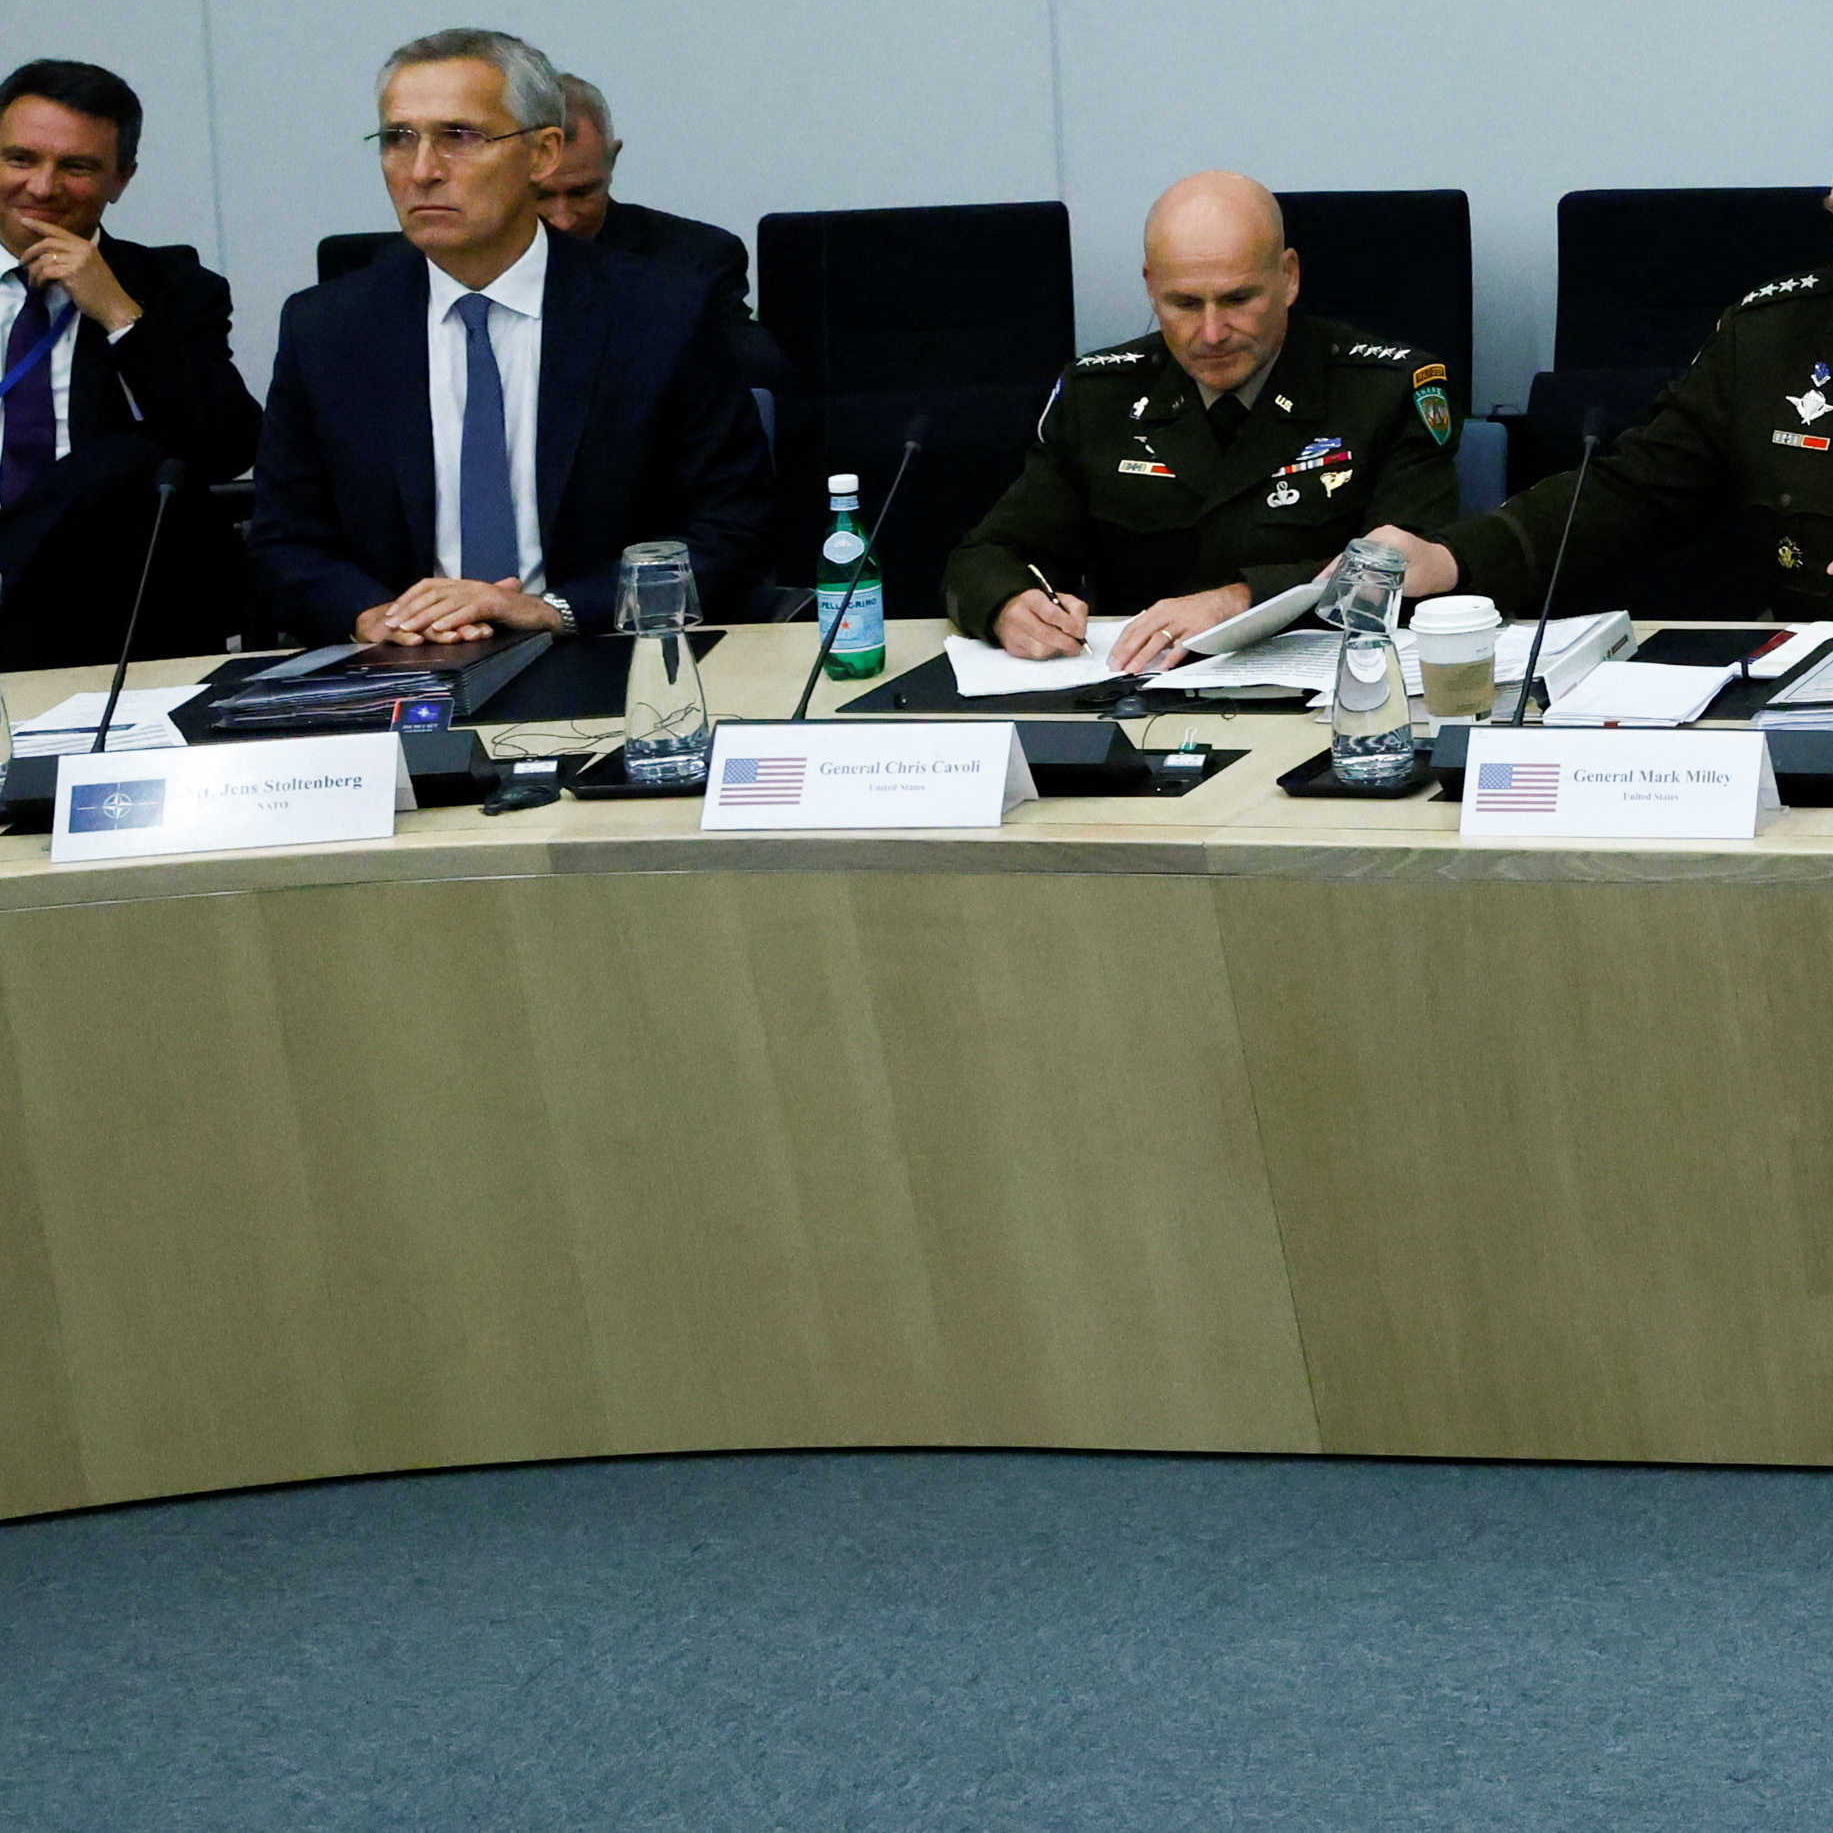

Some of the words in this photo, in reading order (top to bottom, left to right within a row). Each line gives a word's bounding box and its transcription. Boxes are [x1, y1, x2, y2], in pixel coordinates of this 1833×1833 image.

[819, 598, 878, 611] PELLGRINO
[819, 761, 881, 776] General
[885, 760, 927, 775] Chris
[931, 759, 982, 774] Cavoli
[1573, 768, 1634, 784] General
[1638, 768, 1681, 784] Mark
[1685, 768, 1733, 787] Milley
[220, 782, 258, 797] Jens
[263, 774, 363, 794] Stoltenberg
[869, 783, 898, 792] United
[900, 783, 926, 792] States
[1623, 792, 1652, 801] United
[1654, 792, 1679, 801] States
[257, 800, 289, 810] NATO
